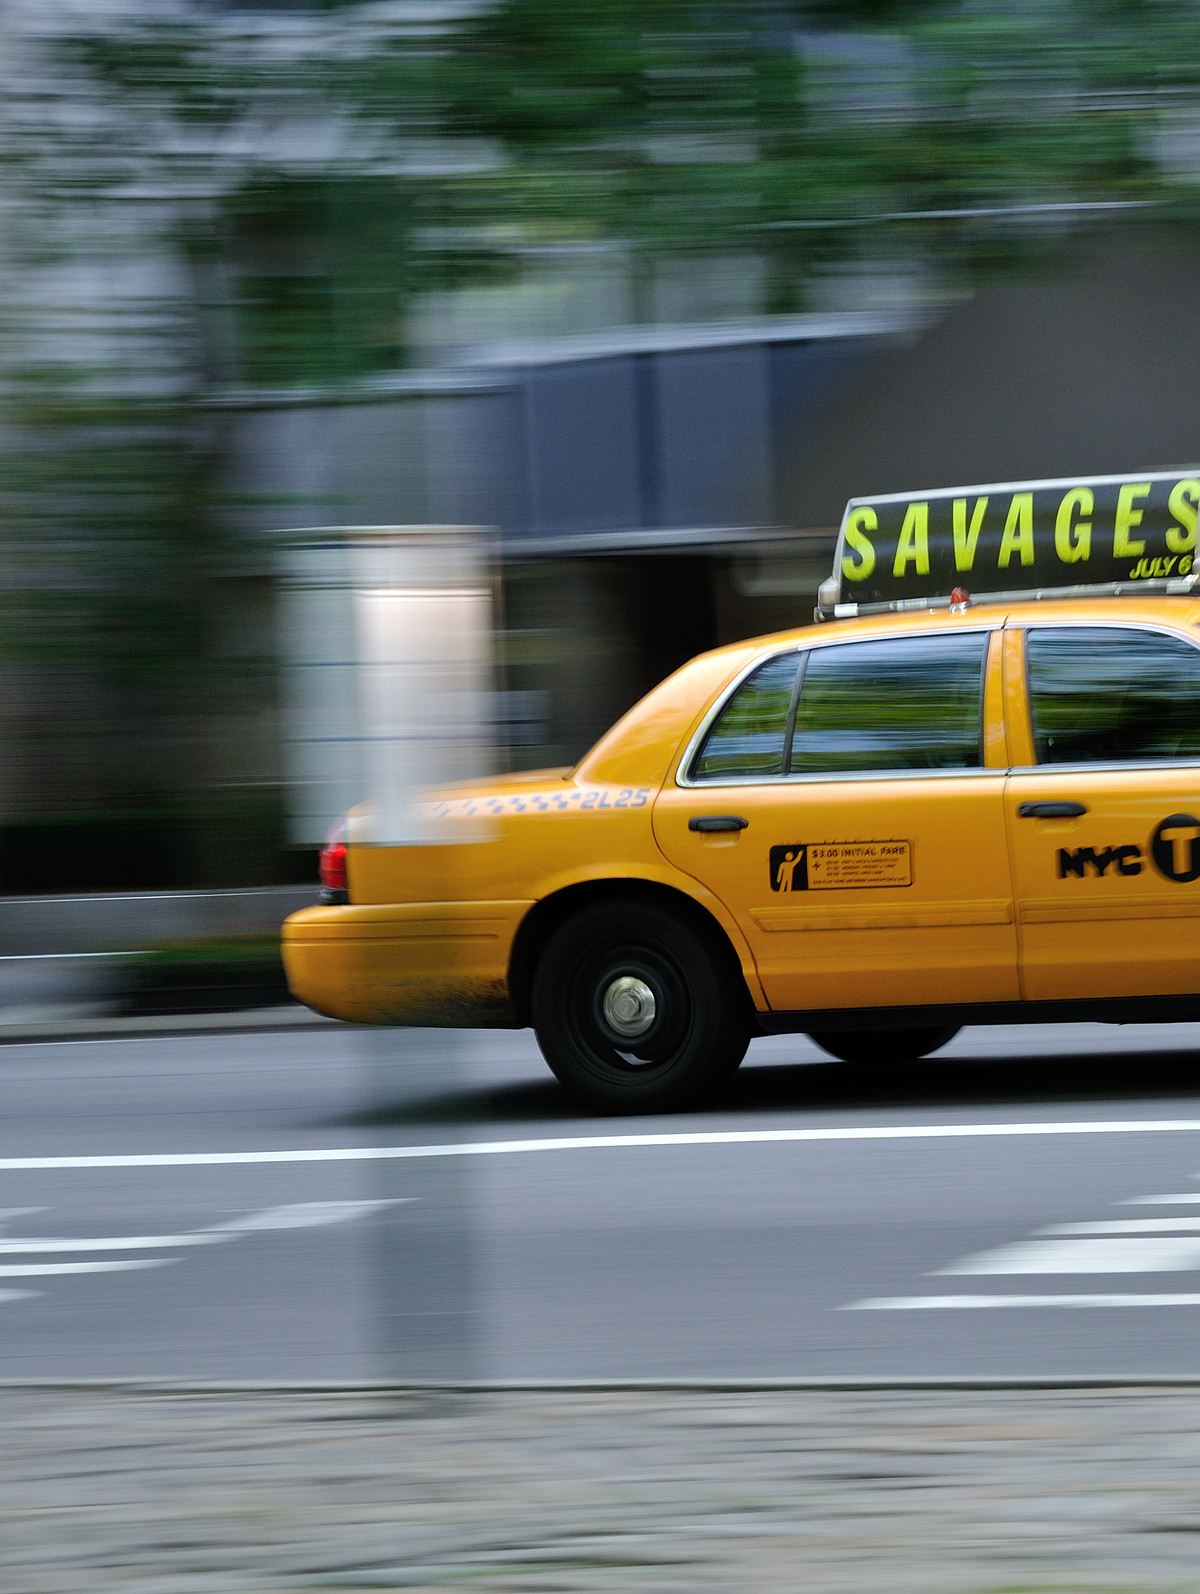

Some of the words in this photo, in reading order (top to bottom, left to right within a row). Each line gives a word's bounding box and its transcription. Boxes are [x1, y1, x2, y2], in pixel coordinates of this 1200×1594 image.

[841, 478, 1200, 582] SAVAGES
[1129, 555, 1179, 579] JULY
[1178, 554, 1193, 575] 6
[580, 788, 650, 809] 2L25
[841, 847, 877, 857] INITIAL
[1056, 845, 1142, 879] NYC
